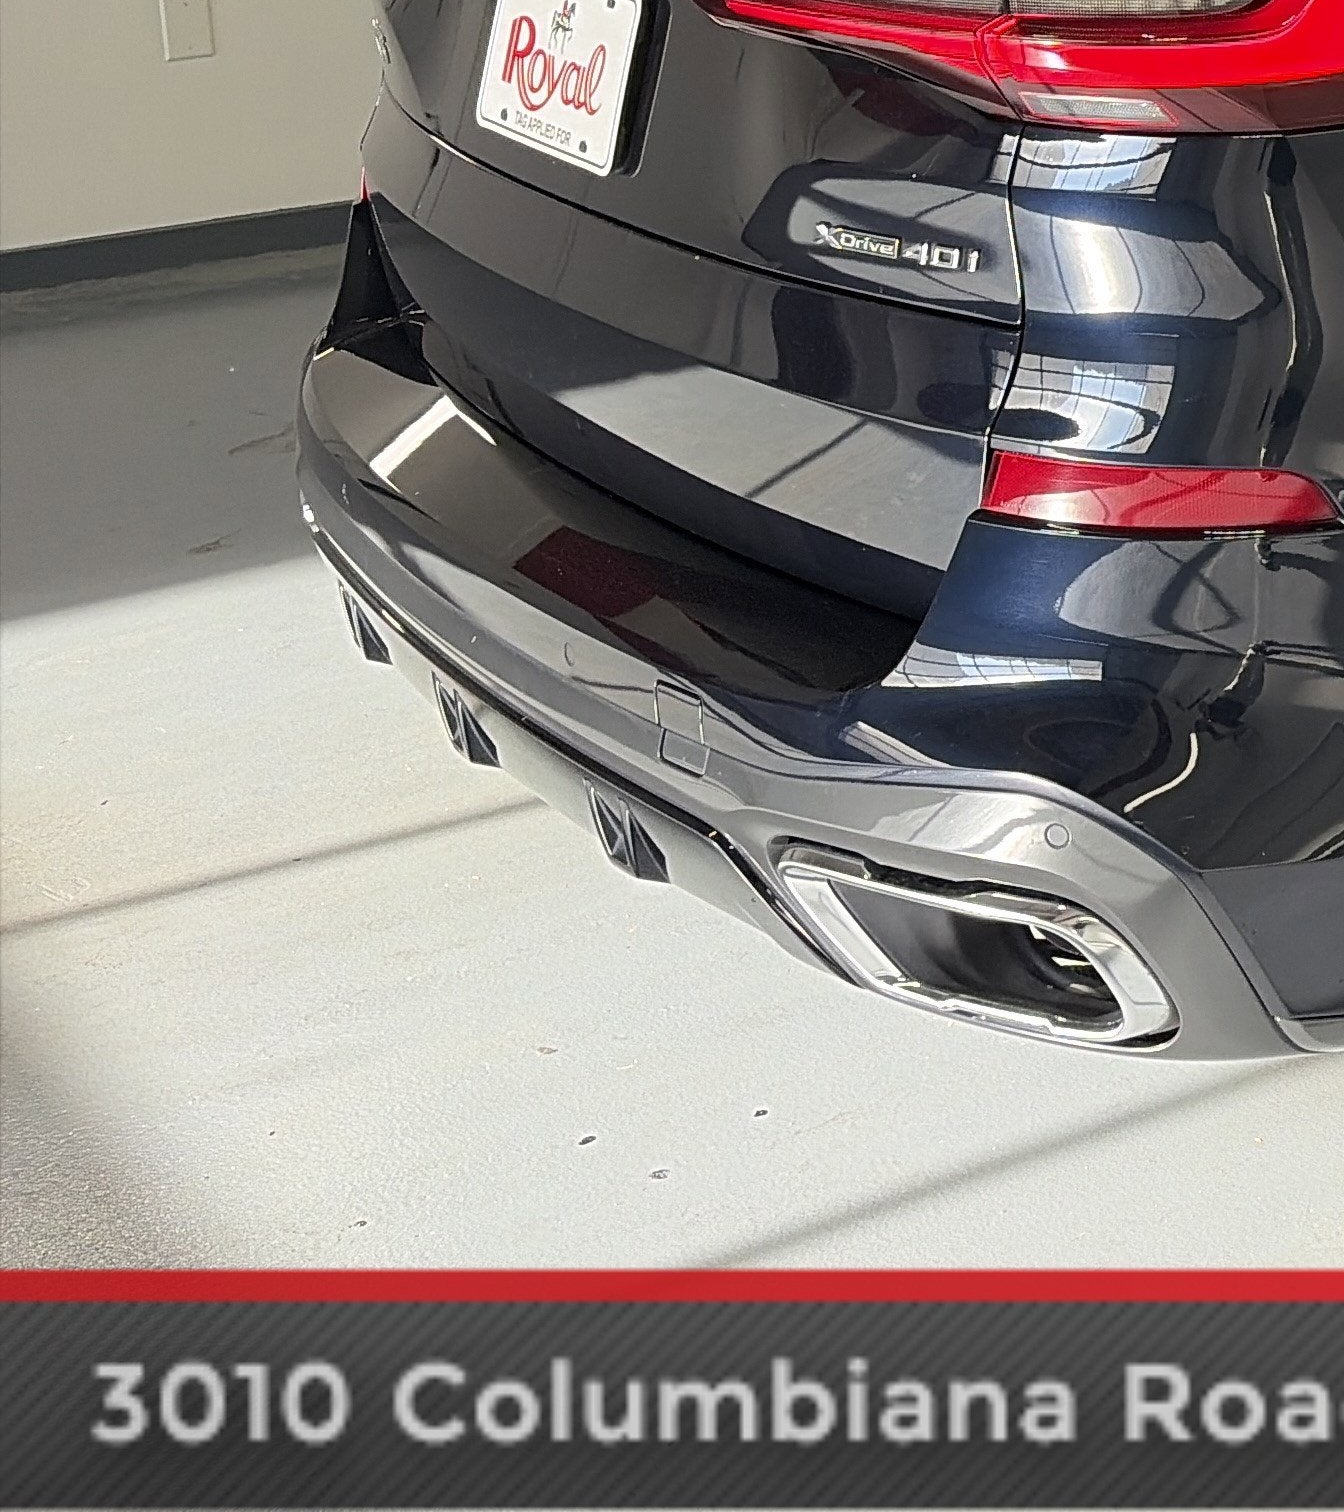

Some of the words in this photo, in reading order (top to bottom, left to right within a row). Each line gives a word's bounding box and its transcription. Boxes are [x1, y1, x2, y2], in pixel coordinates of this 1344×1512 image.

[502, 15, 606, 116] Royal
[515, 110, 528, 129] TAG
[527, 117, 556, 140] APPLIED
[556, 128, 572, 146] FOR
